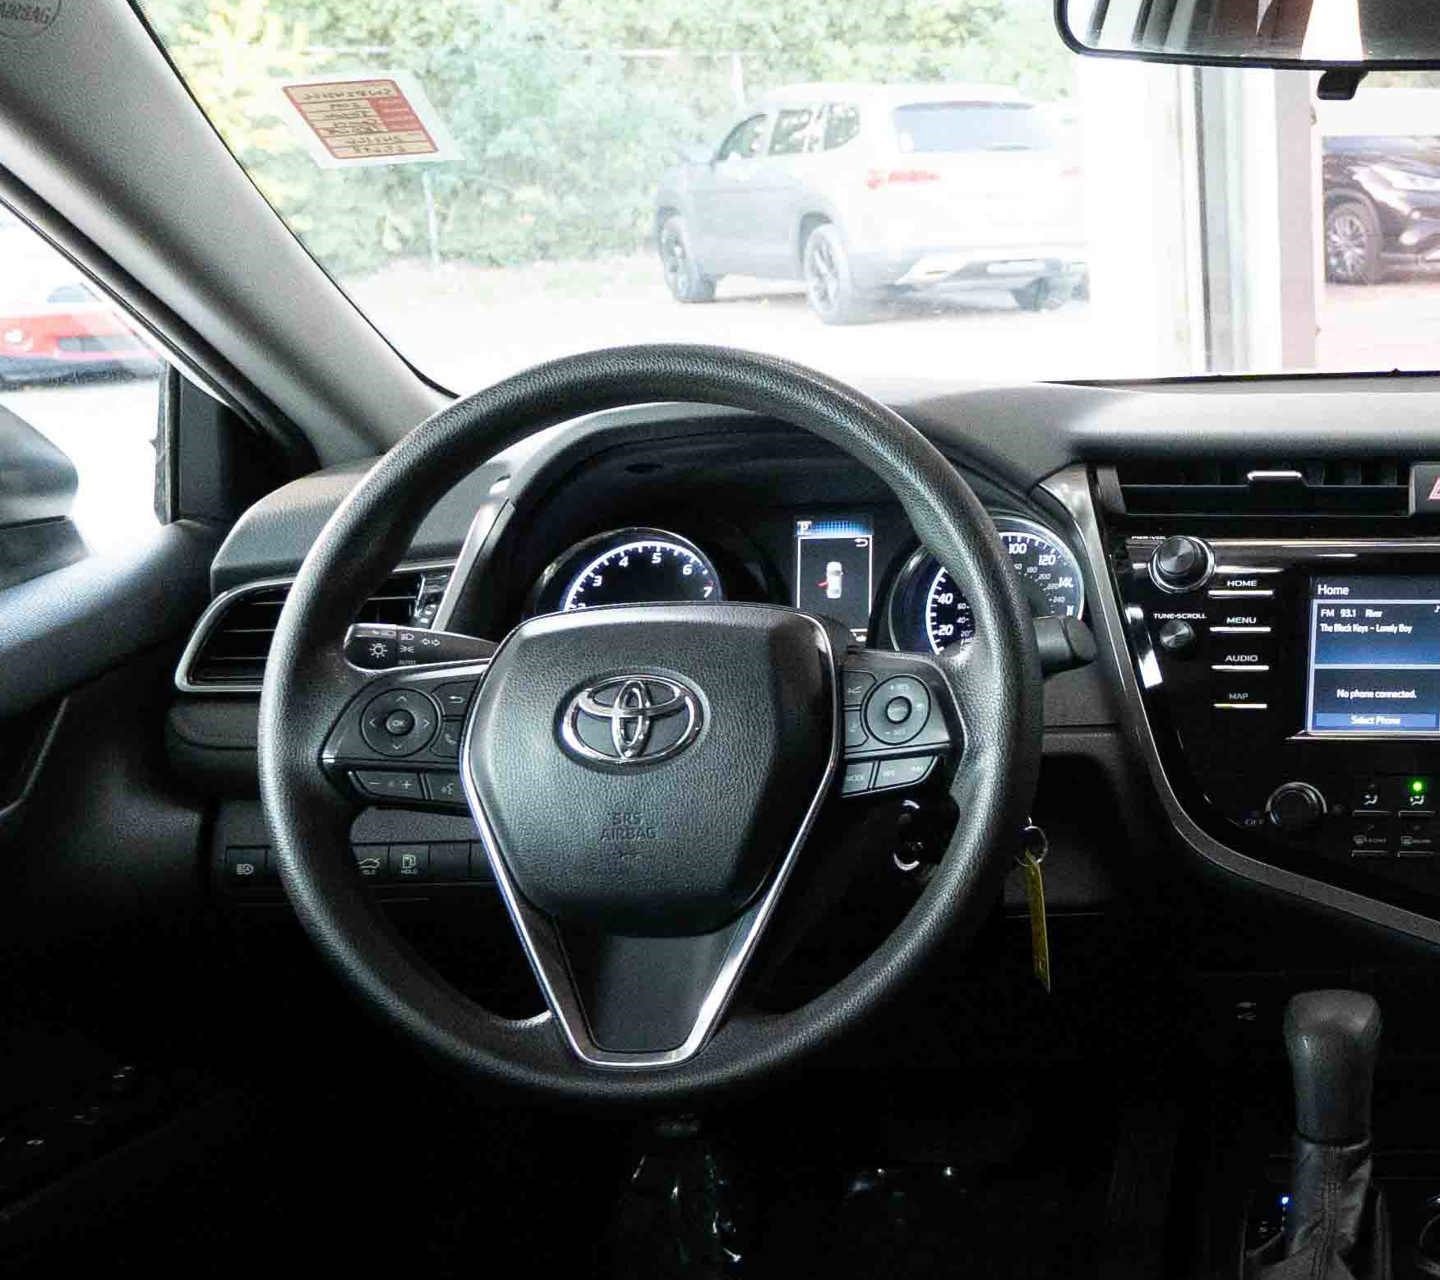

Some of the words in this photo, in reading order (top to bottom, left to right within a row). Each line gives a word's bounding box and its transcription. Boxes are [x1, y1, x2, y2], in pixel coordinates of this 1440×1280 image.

[1009, 543, 1027, 554] 100
[618, 556, 629, 568] 4
[651, 553, 661, 564] 5
[1038, 554, 1056, 566] 120
[682, 564, 693, 575] 6
[592, 575, 602, 587] 3
[703, 586, 713, 598] 7
[1318, 584, 1350, 596] Home
[936, 592, 954, 605] 40
[1320, 608, 1335, 618] FM
[1340, 608, 1357, 618] 93.1
[1226, 616, 1257, 624] MENU
[937, 623, 954, 636] 20
[1320, 623, 1333, 633] The
[1225, 654, 1258, 662] AUDIO
[1229, 692, 1249, 700] MAP
[1336, 688, 1349, 699] No
[1349, 688, 1374, 700] phone
